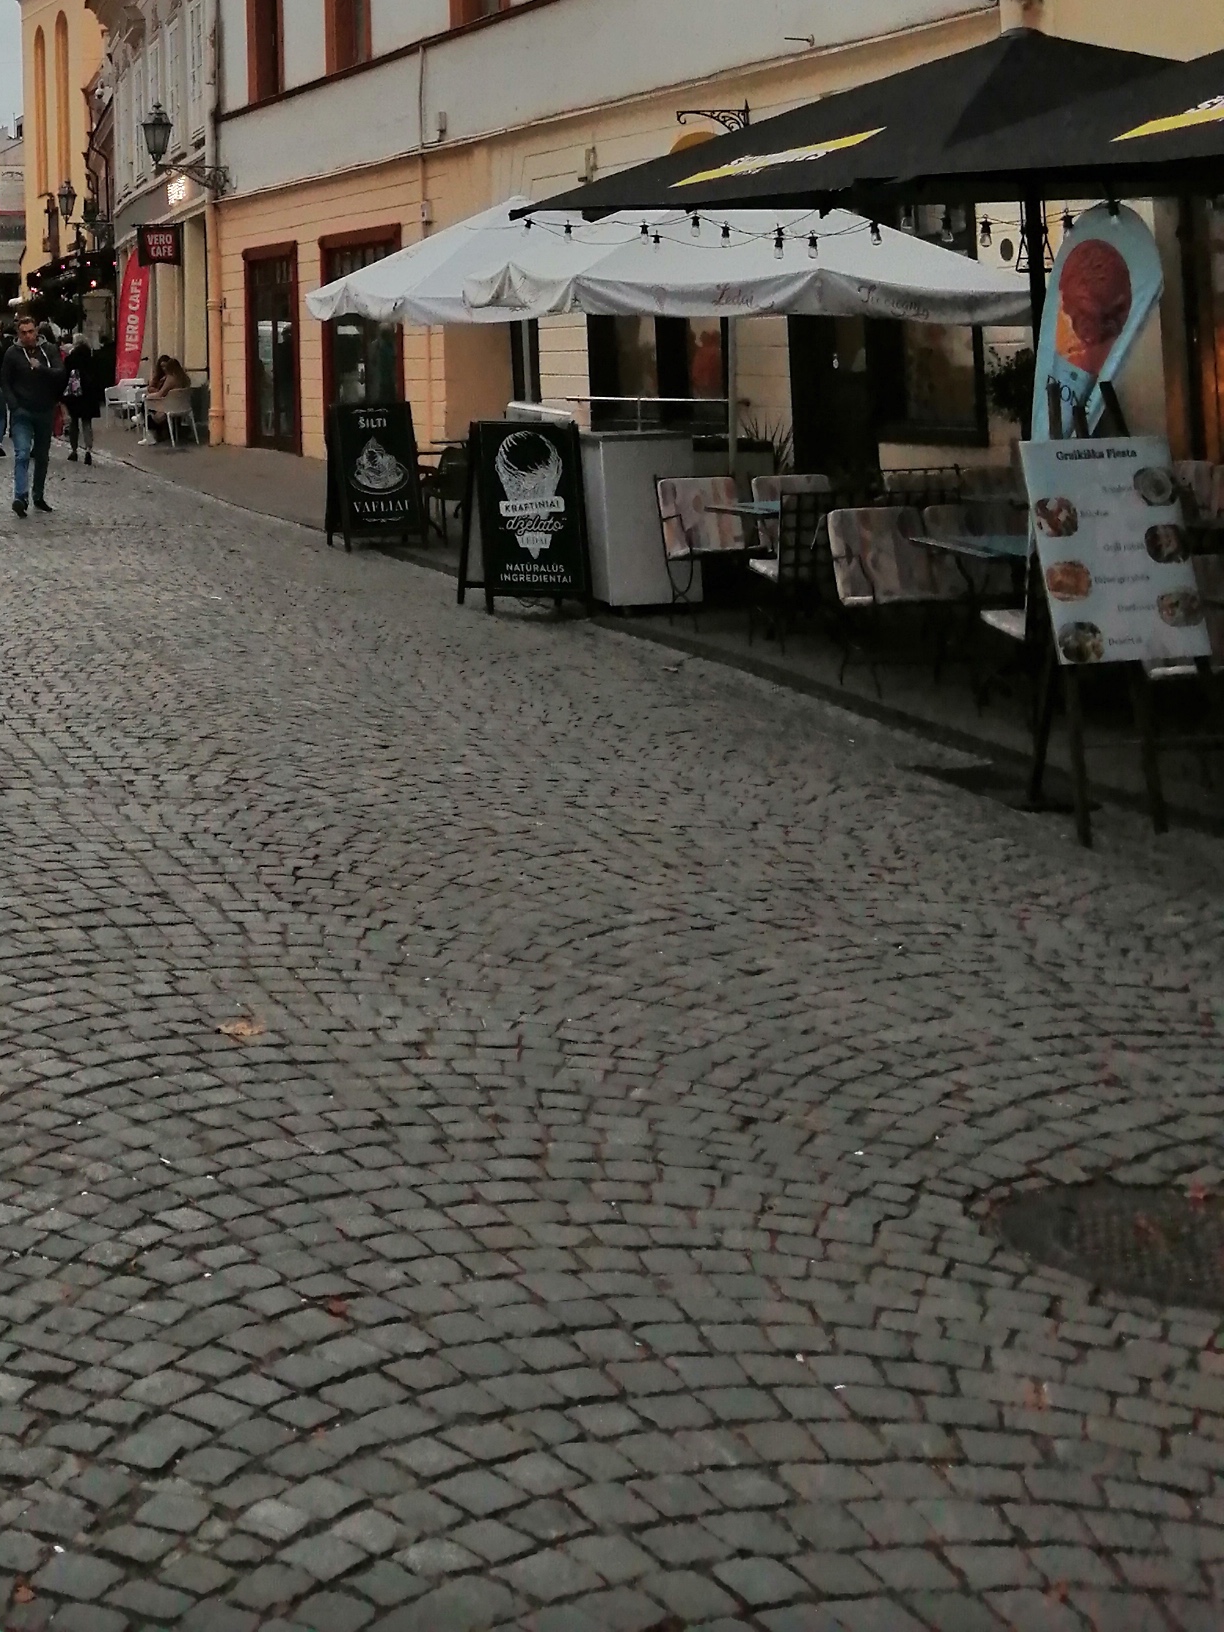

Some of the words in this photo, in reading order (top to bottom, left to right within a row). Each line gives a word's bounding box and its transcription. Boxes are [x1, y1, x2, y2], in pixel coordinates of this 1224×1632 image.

[147, 234, 173, 246] VERO
[151, 245, 173, 257] CAFE
[128, 278, 143, 310] CAFE
[125, 314, 140, 352] VERO
[358, 416, 387, 429] ŠILTI
[353, 499, 411, 513] VAFLIAI
[505, 500, 559, 513] KRAFTINIAI
[499, 572, 573, 584] INGREDIENTAI
